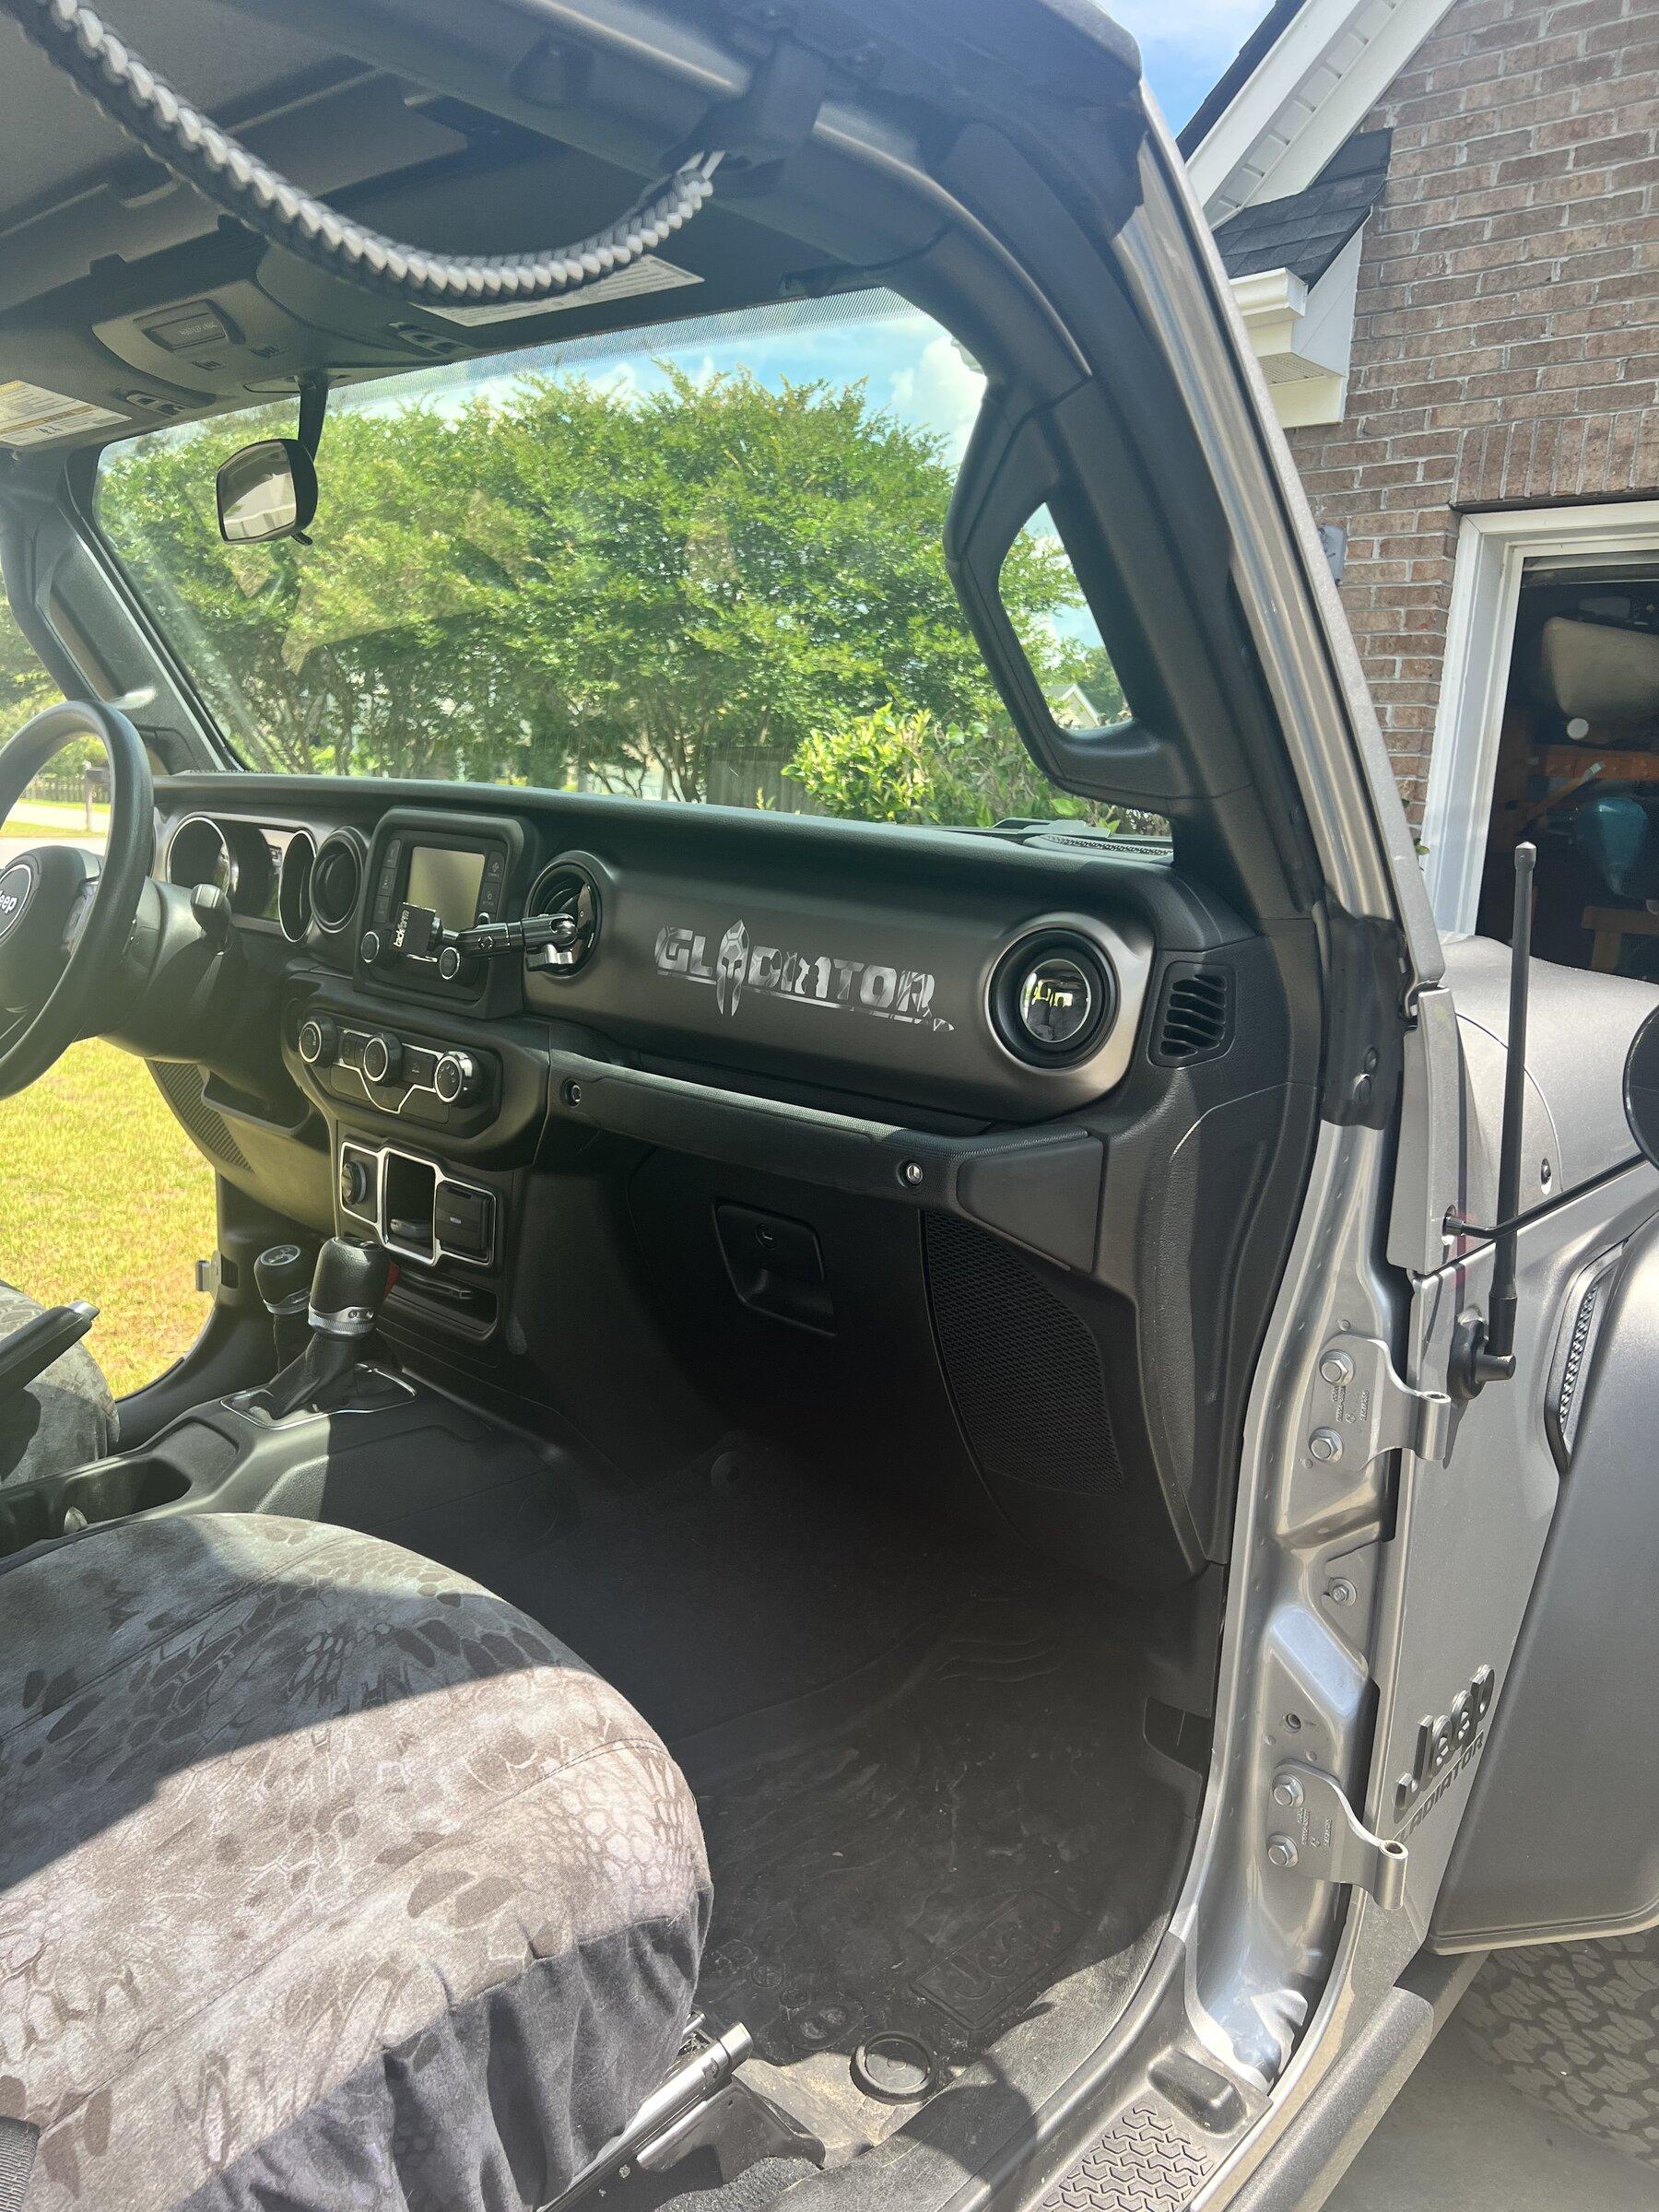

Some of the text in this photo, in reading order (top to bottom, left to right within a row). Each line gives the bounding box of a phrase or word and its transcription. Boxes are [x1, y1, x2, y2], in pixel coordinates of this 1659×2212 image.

[0, 889, 18, 914] eep
[1394, 1665, 1495, 1824] Jeep
[1394, 1729, 1485, 1843] LADIATOR
